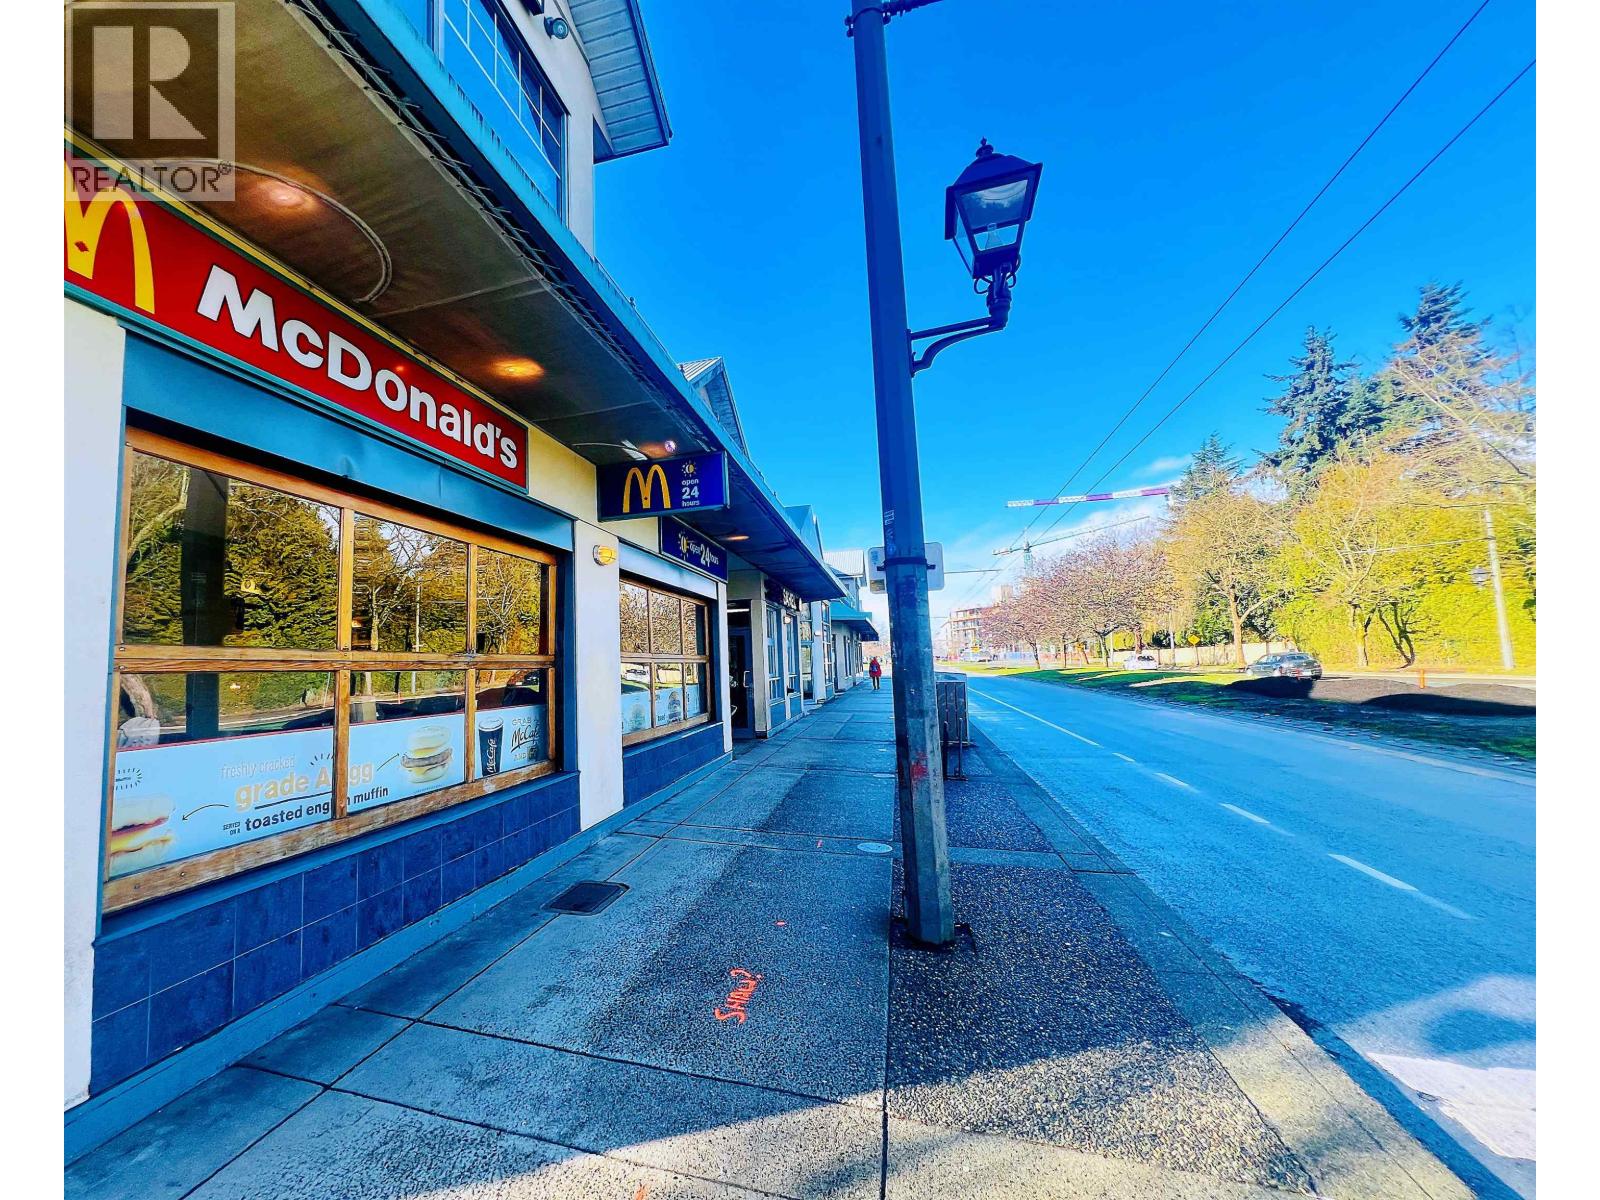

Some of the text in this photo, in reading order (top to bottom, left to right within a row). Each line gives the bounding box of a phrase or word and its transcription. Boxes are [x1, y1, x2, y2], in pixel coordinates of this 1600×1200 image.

[197, 264, 518, 470] McDonald's
[682, 486, 699, 500] 24
[700, 544, 710, 567] 24
[235, 763, 374, 814] grade A gg
[244, 805, 303, 831] toasted
[353, 786, 389, 804] muffin
